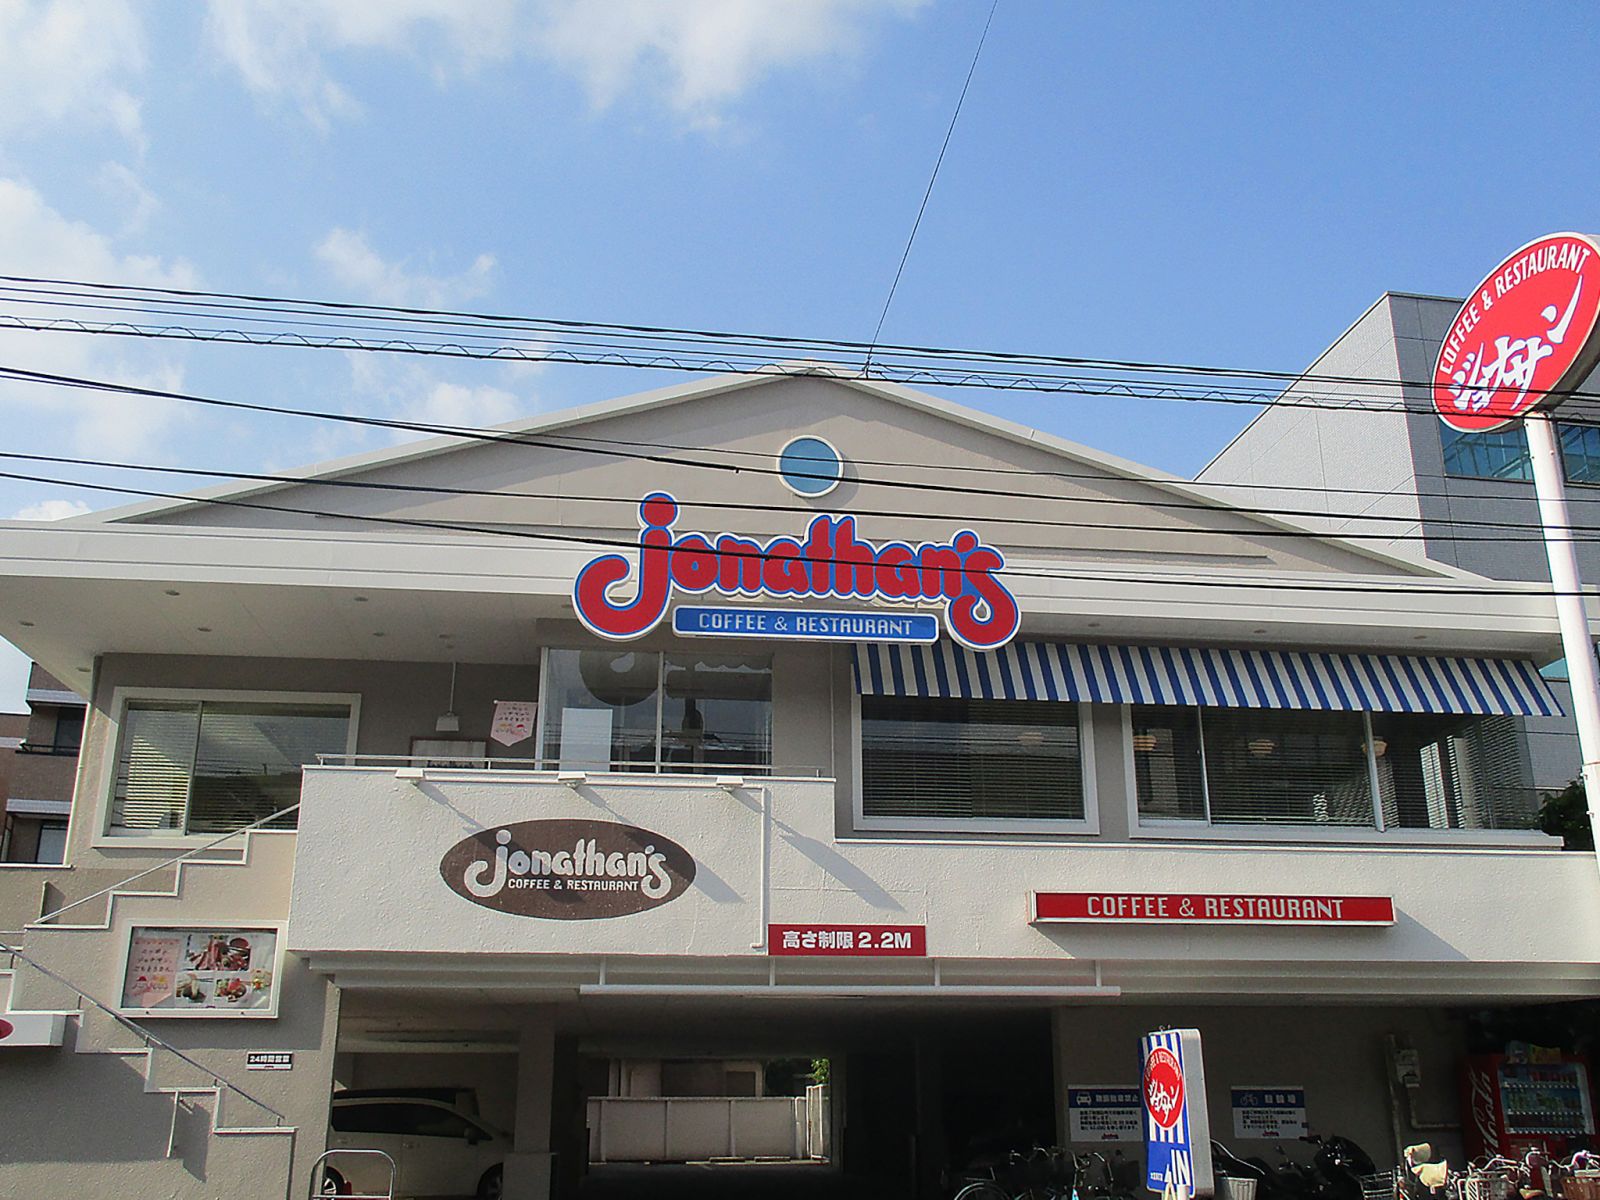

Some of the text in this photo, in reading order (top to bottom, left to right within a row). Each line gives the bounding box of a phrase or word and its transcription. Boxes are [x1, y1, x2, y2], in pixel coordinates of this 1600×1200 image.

[1439, 243, 1590, 375] COFFEE & RESTAURANT
[699, 611, 913, 636] COFFEE & RESTAURANT
[508, 878, 639, 892] COFFEE & RESTAURANT
[1087, 896, 1343, 919] COFFEE & RESTAURANT
[782, 930, 854, 949] 高さ制限
[1170, 1149, 1191, 1186] IN
